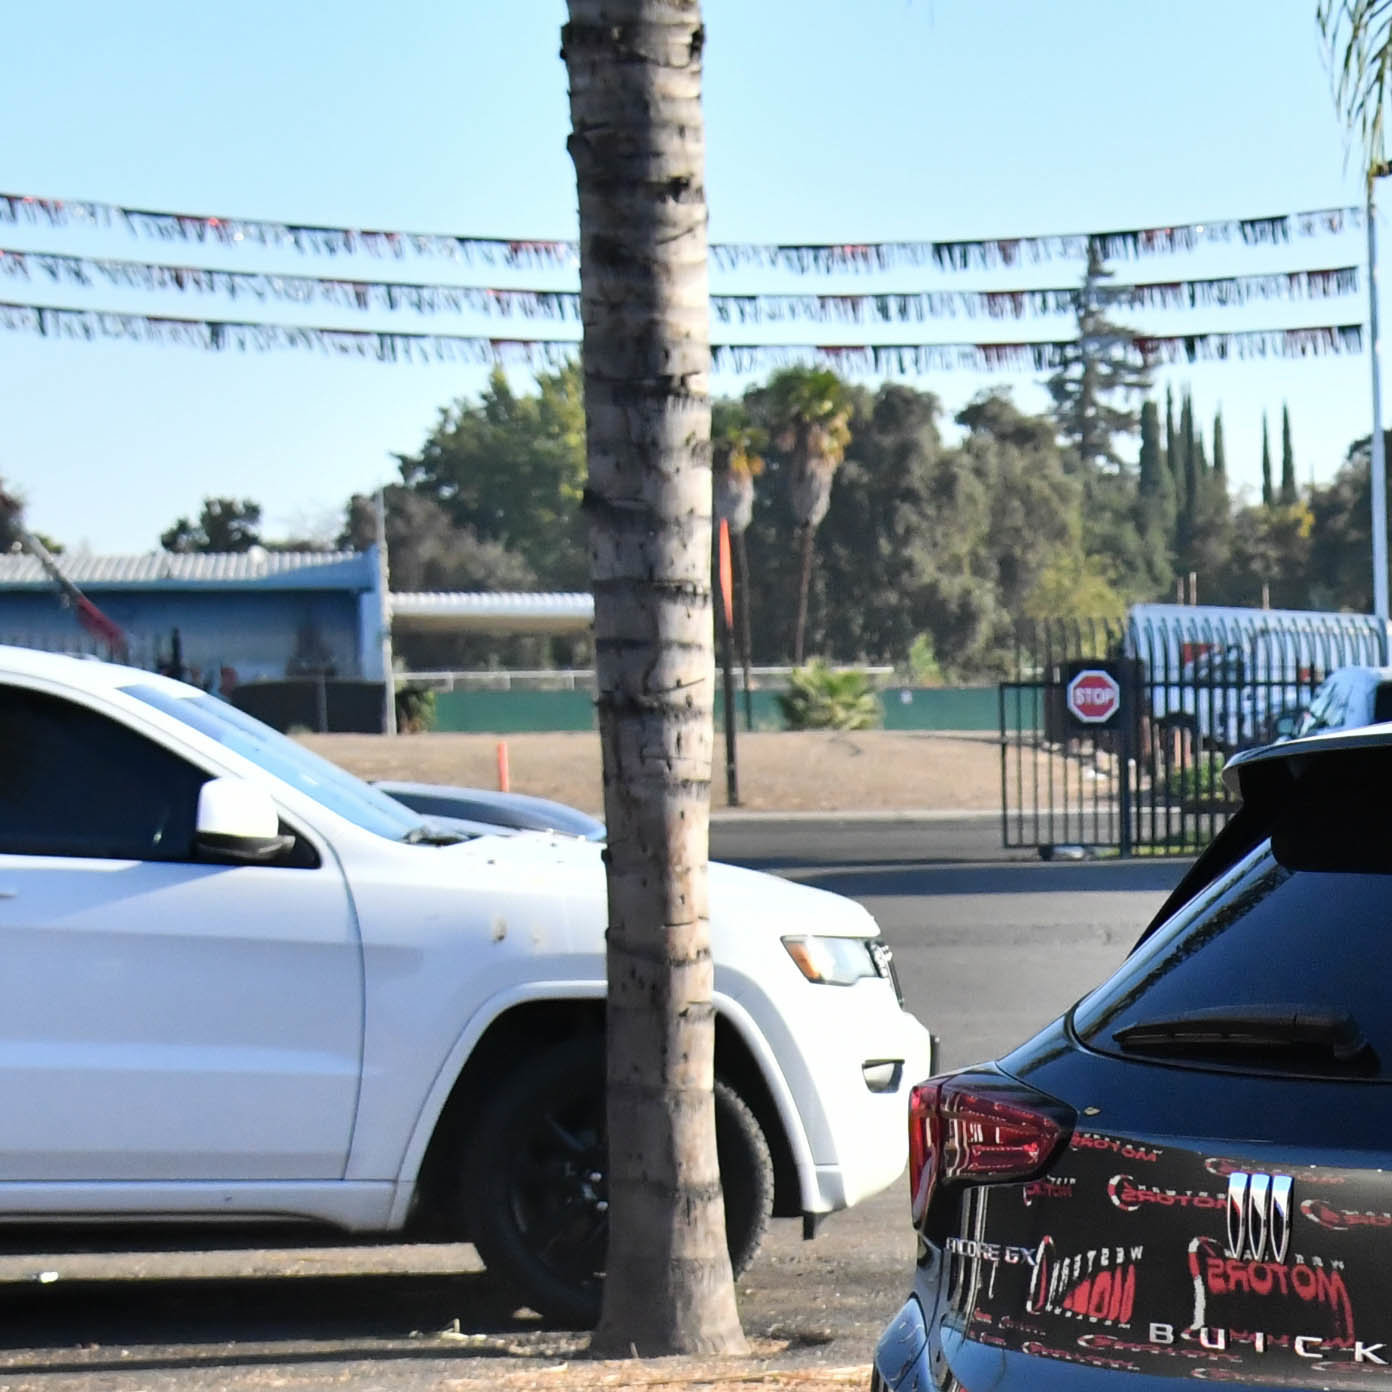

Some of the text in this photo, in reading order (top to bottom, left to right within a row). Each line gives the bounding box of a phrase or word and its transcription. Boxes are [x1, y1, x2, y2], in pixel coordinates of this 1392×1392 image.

[1074, 687, 1115, 705] STOP
[1005, 1246, 1037, 1266] GX
[1148, 1322, 1388, 1365] BUICK
